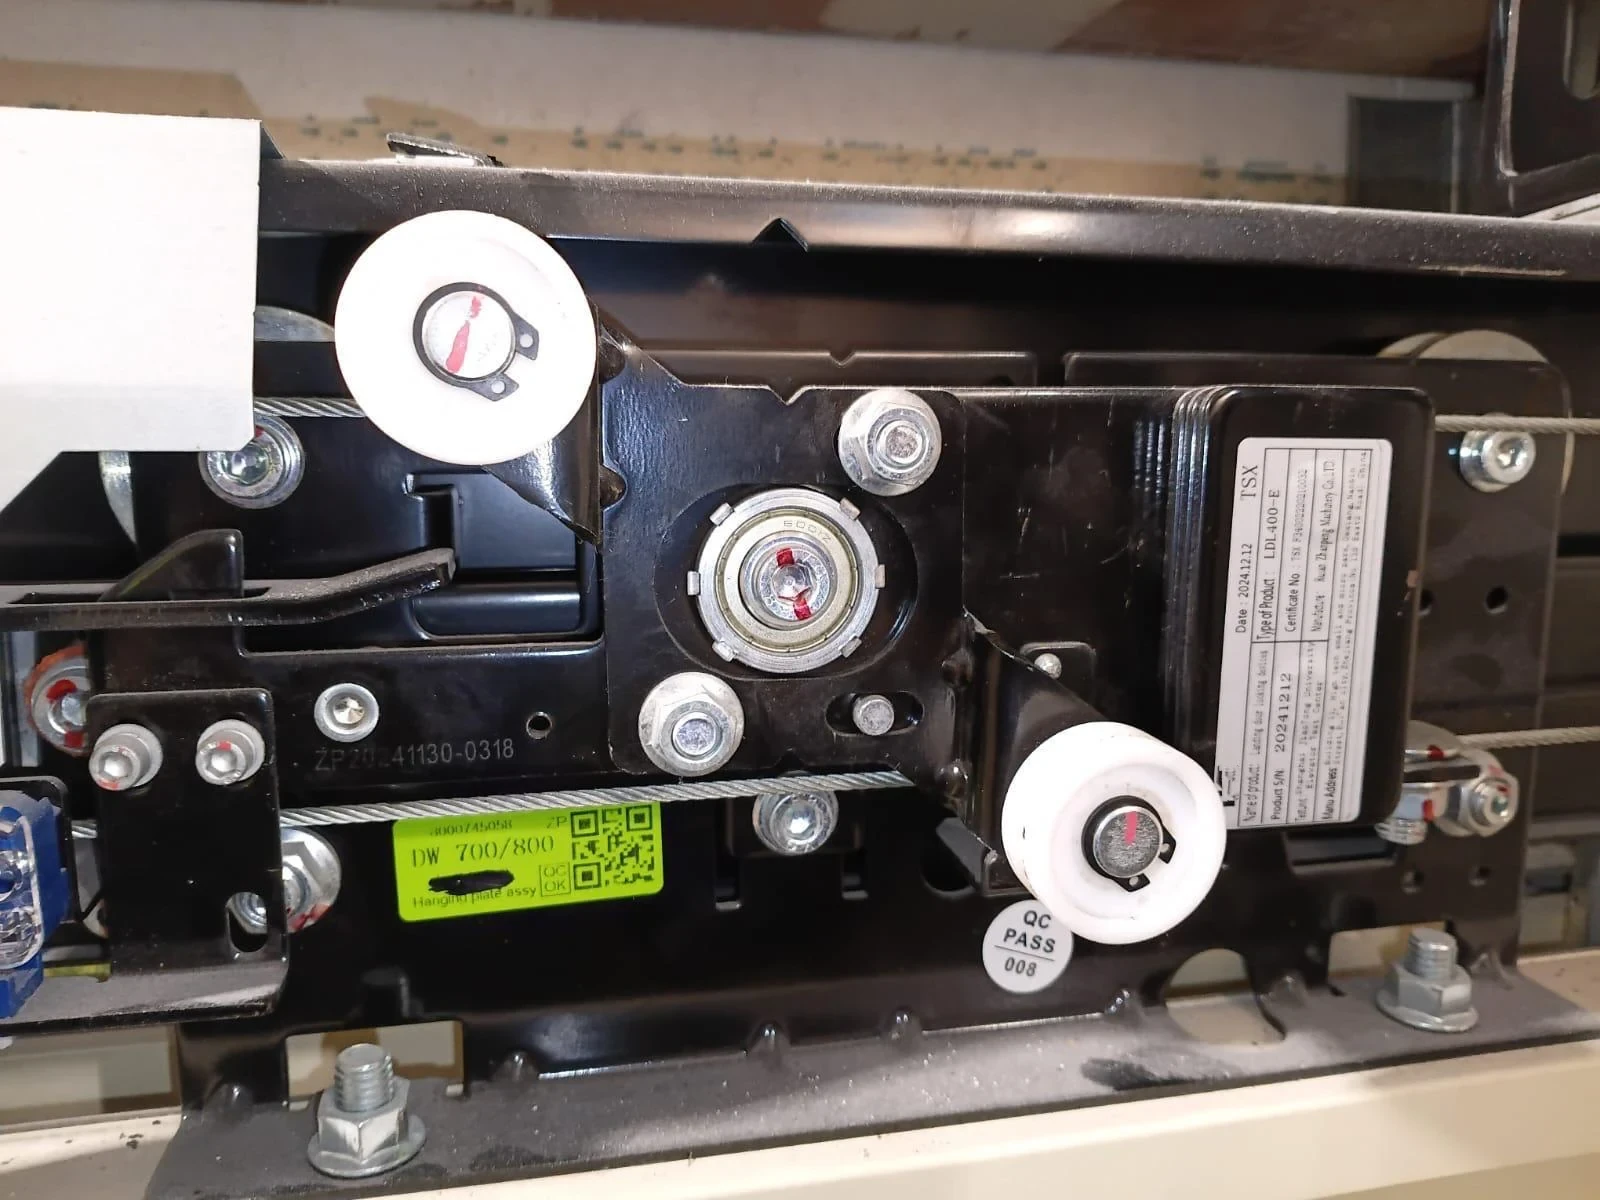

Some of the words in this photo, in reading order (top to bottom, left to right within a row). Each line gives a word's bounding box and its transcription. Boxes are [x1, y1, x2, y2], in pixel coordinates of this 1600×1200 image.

[1240, 465, 1259, 498] TSX
[1263, 489, 1281, 558] LDL400-E
[1238, 543, 1253, 598] 2024.12.12
[1288, 573, 1301, 586] No
[1259, 578, 1275, 608] Product
[1236, 609, 1248, 633] Date
[1258, 609, 1273, 618] of
[1284, 589, 1300, 632] Certificate
[1257, 620, 1274, 639] Type
[1274, 672, 1292, 752] 20241212
[1273, 769, 1286, 785] S/N
[1270, 788, 1284, 820] Product
[412, 846, 440, 868] DW
[456, 836, 554, 862] 700/800
[507, 886, 536, 898] assy
[545, 880, 566, 892] OK
[1024, 910, 1051, 929] QC
[1004, 928, 1056, 953] PASS
[1004, 957, 1037, 977] 008
